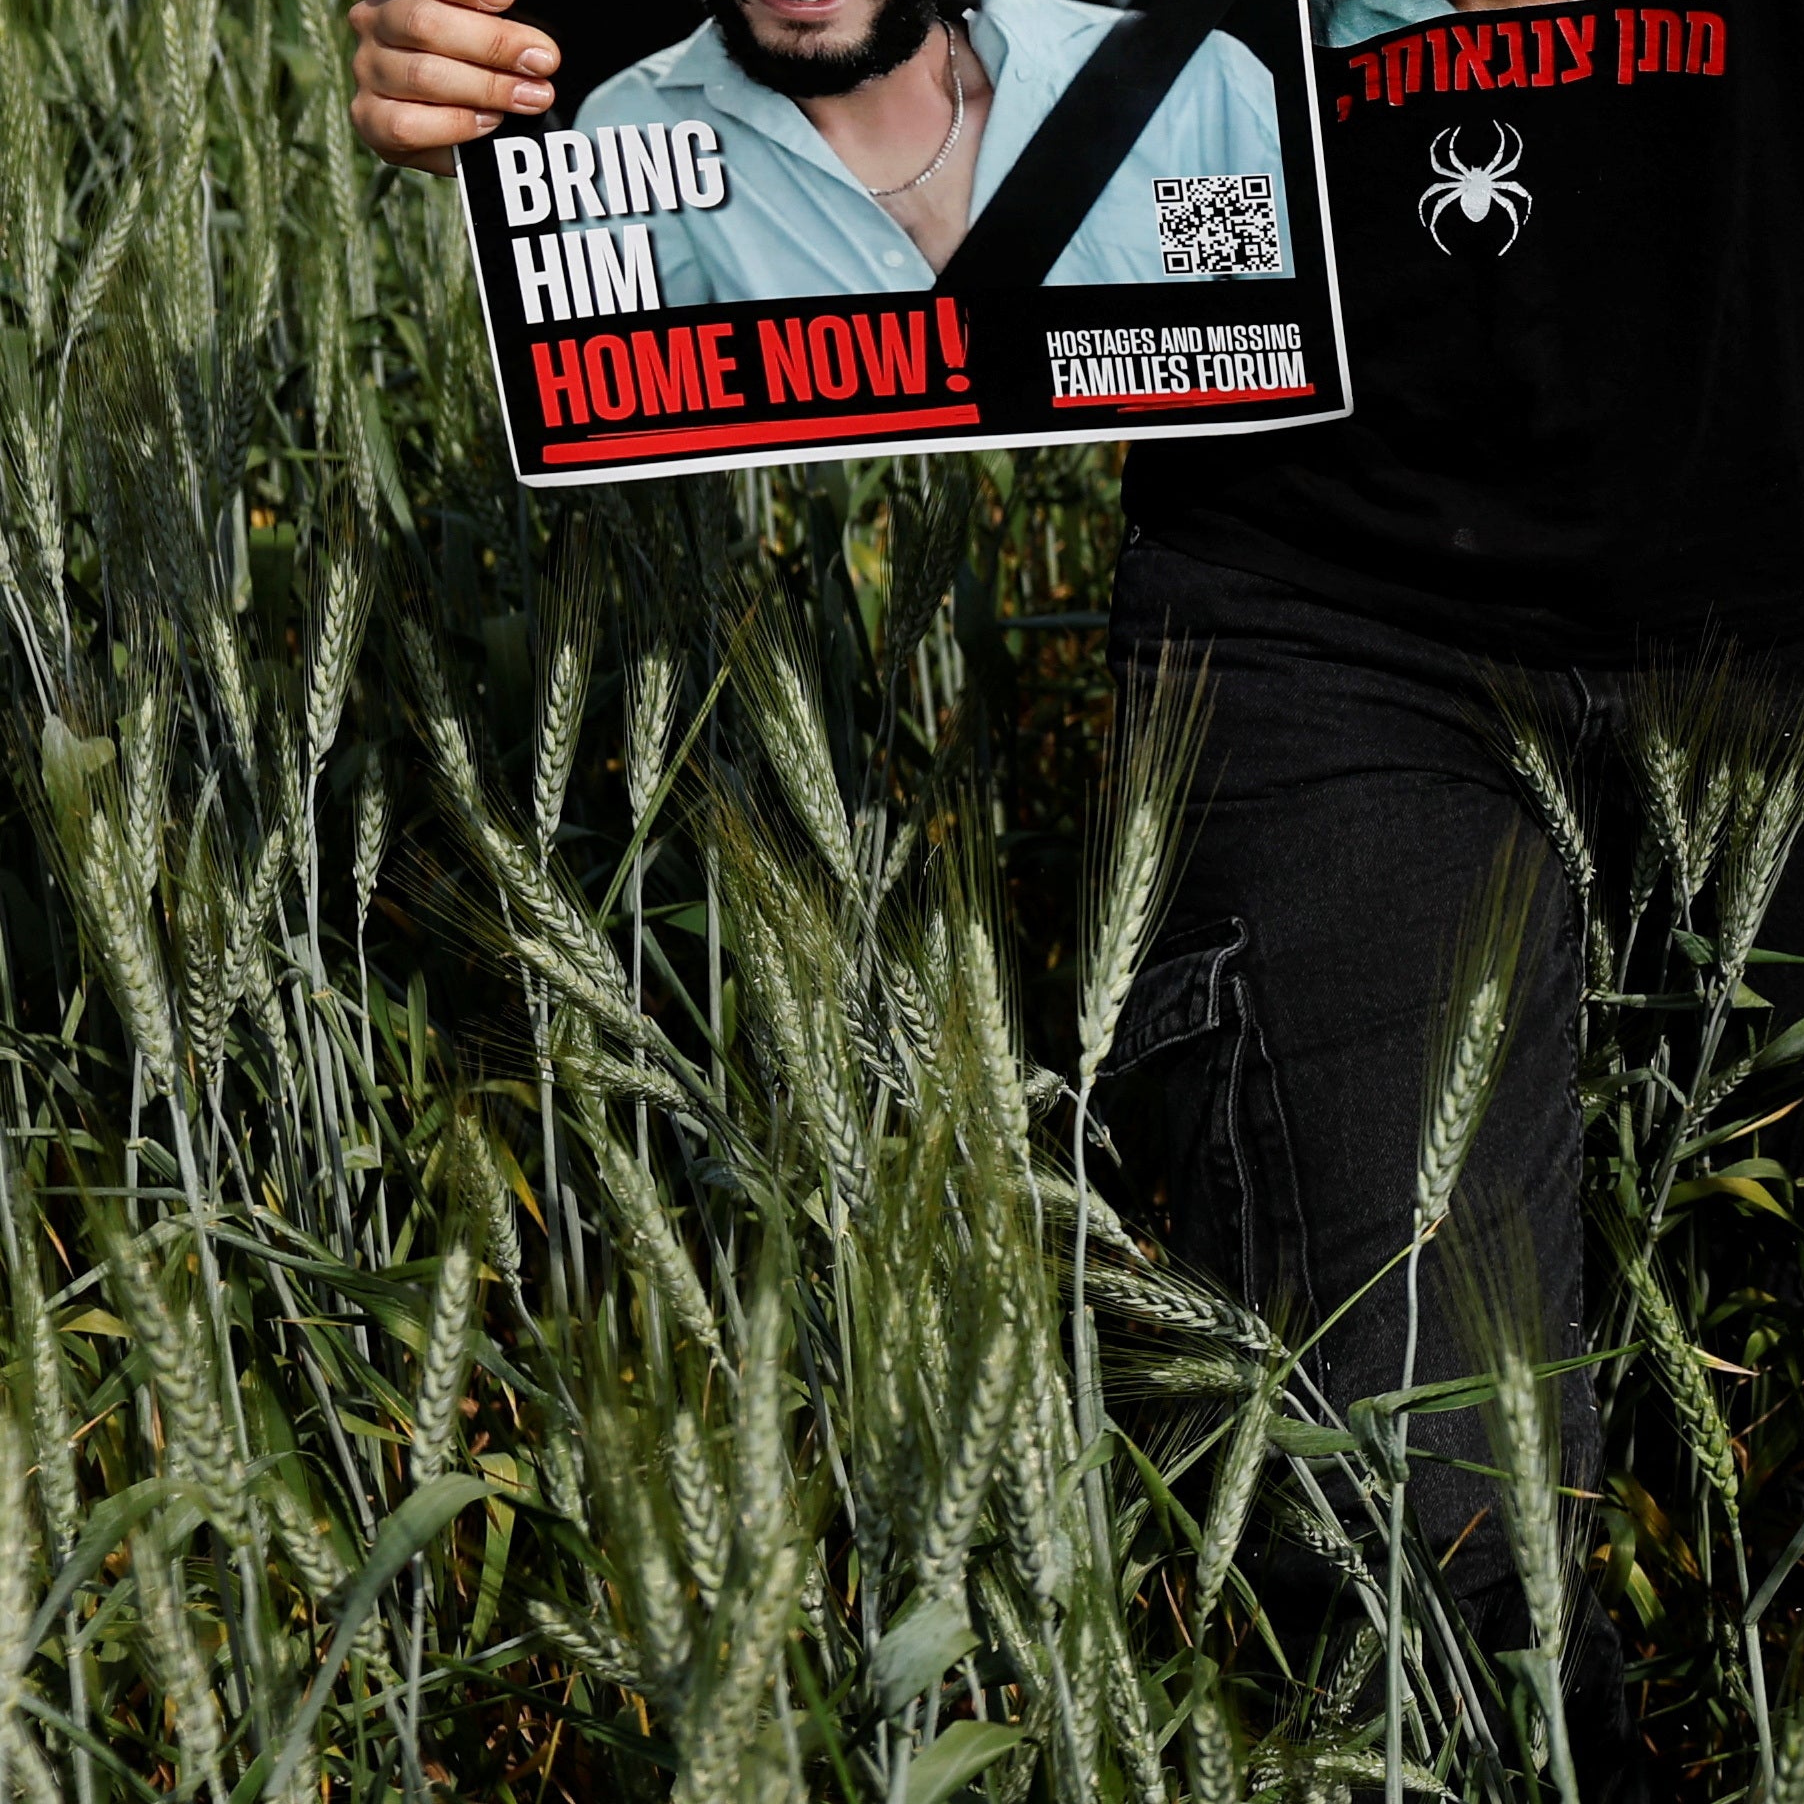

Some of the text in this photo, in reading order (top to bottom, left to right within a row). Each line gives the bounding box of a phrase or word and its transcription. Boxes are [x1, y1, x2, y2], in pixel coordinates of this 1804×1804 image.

[1336, 7, 1728, 122] מתן צנגאוקר,
[493, 120, 725, 227] BRING
[511, 223, 660, 325] HIM
[529, 296, 973, 429] HOME NOW!
[1046, 323, 1302, 358] HOSTAGES AND MISSING
[1050, 350, 1307, 398] FAMILIES FORUM
